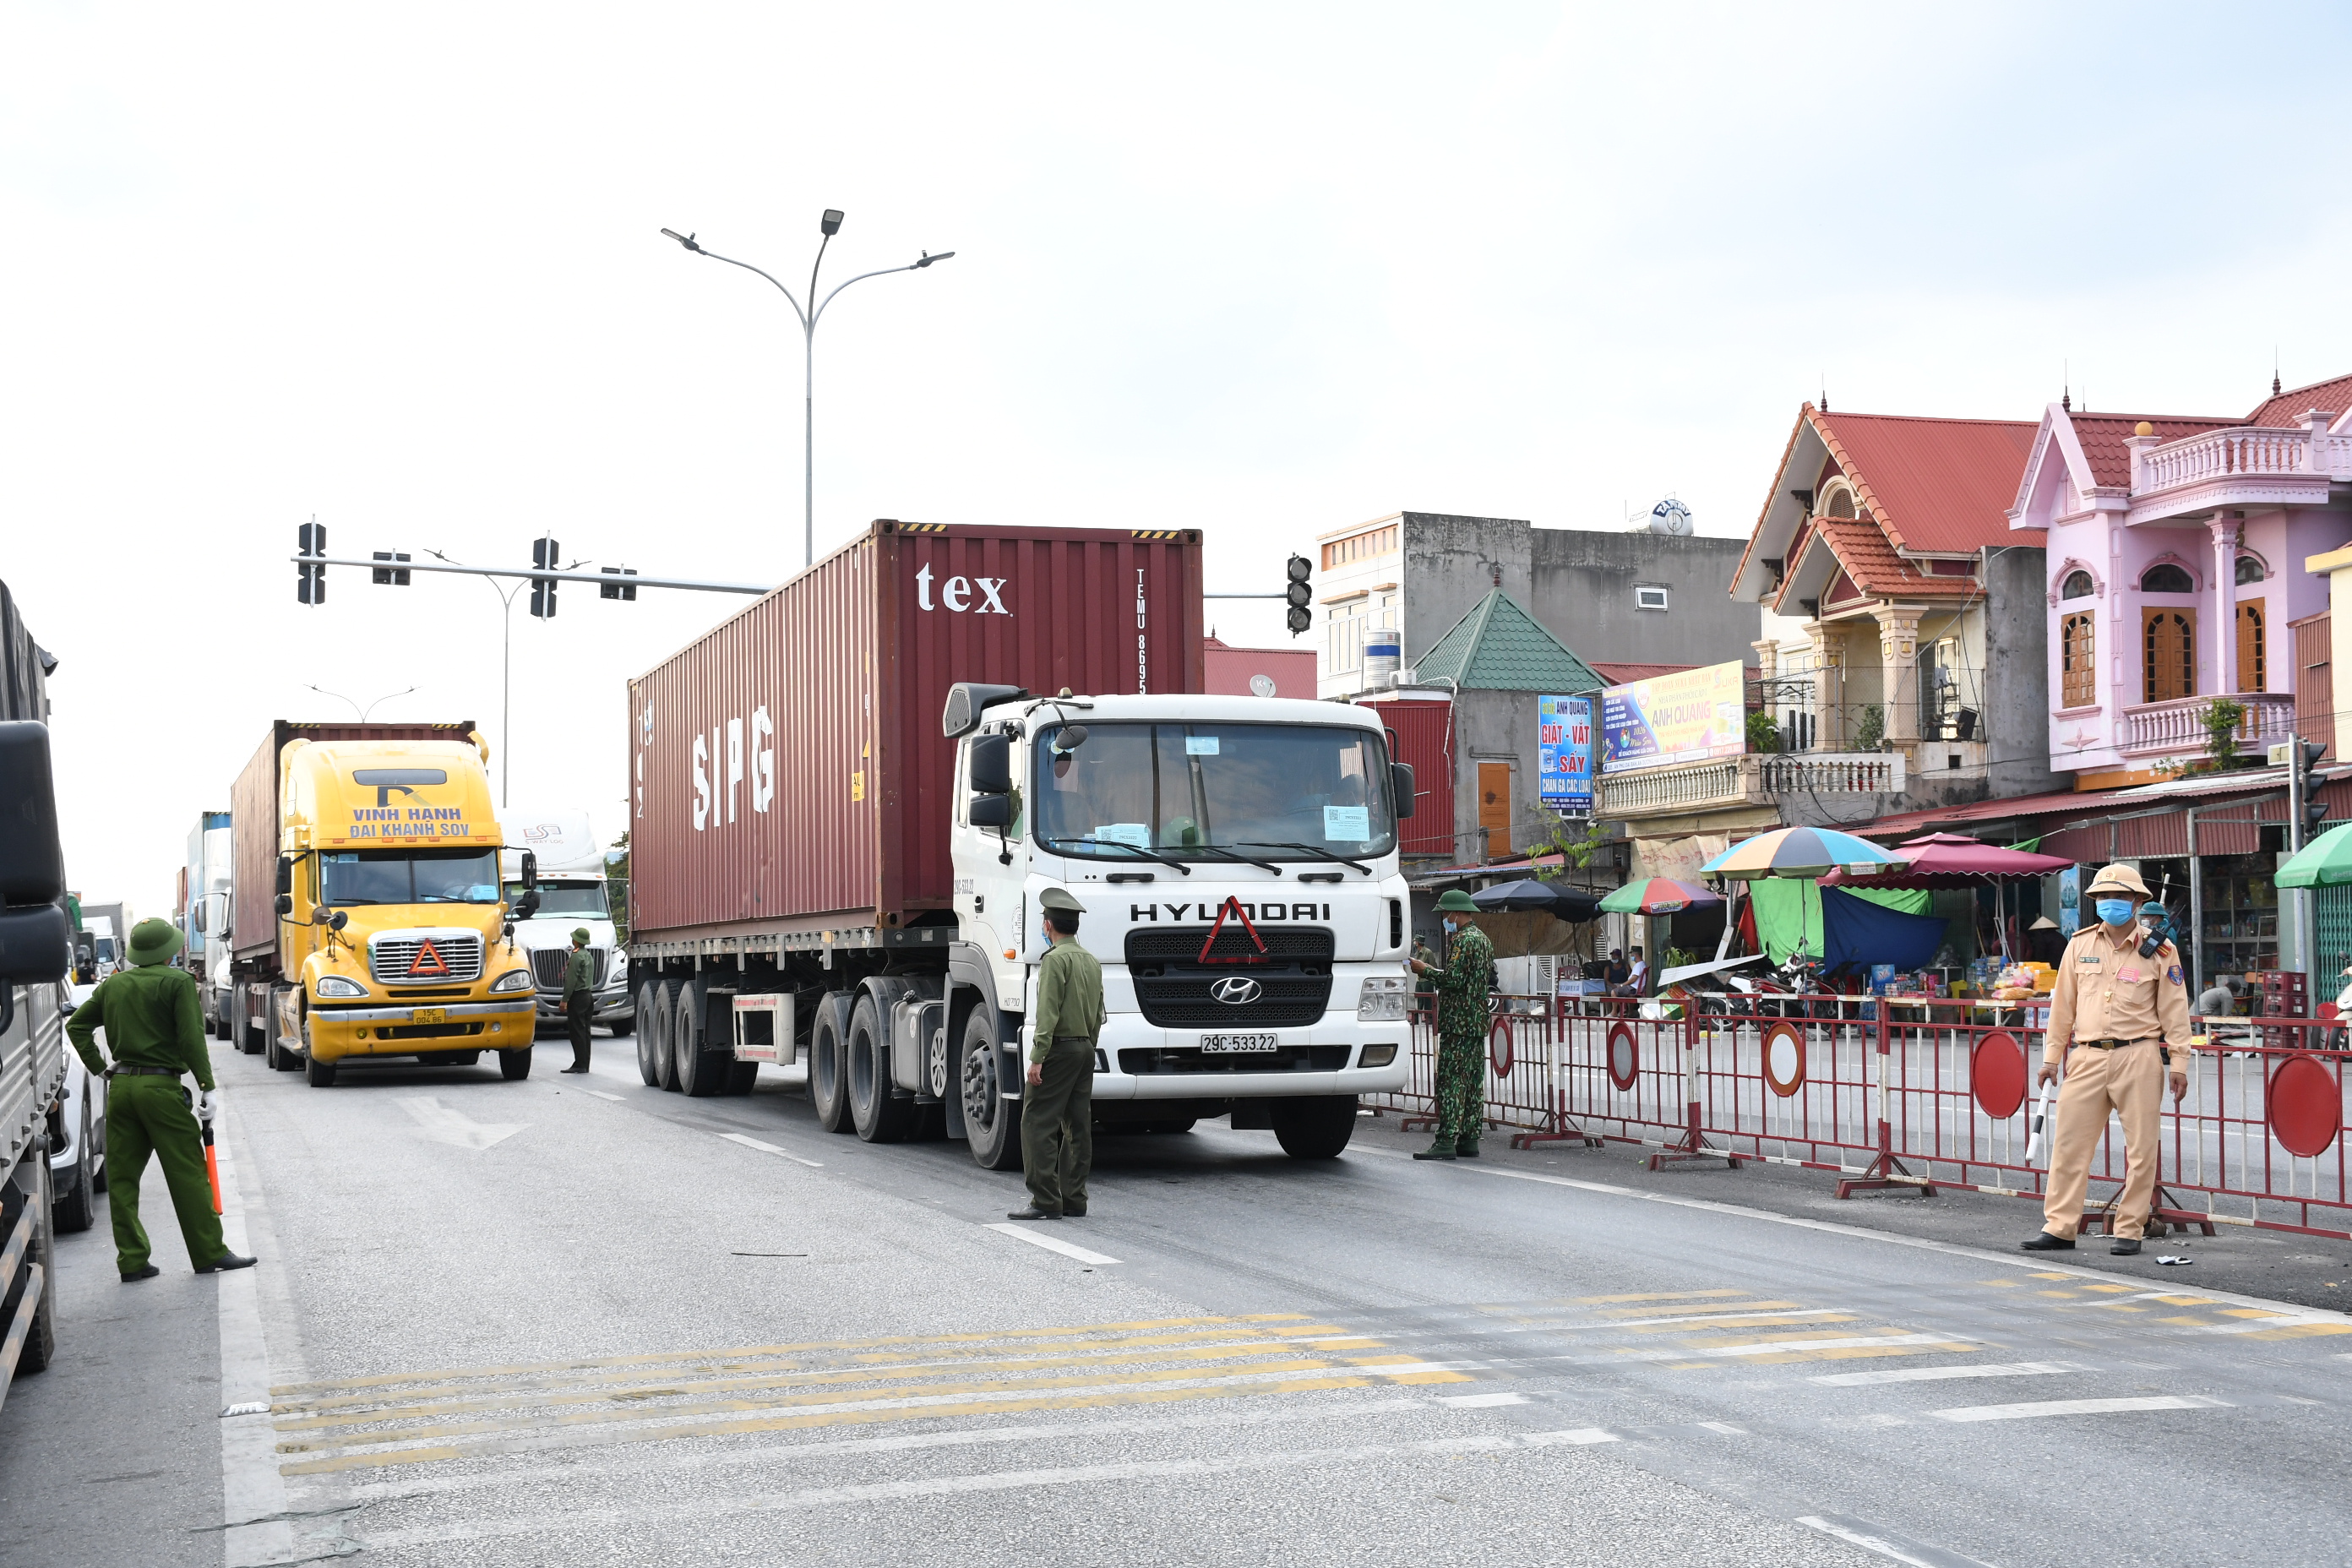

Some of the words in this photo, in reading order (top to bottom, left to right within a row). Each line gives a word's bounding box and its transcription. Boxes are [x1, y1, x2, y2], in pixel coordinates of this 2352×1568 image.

[1136, 569, 1146, 629] TEMU
[1556, 701, 1568, 715] ANH
[1570, 701, 1588, 716] QUANG
[1652, 707, 1673, 728] ANH
[1674, 700, 1711, 724] QUANG
[1541, 721, 1563, 749] GIẶT
[1571, 719, 1590, 744] VẮT
[693, 704, 775, 832] SIPG
[1560, 750, 1586, 773] SẤY
[1558, 778, 1566, 792] GA
[1566, 776, 1578, 793] CÁC
[1578, 778, 1591, 796] LOẠI
[353, 808, 400, 821] VINH
[1130, 903, 1331, 922] HYUNDAI
[1203, 1036, 1276, 1052] 29C-533.22
